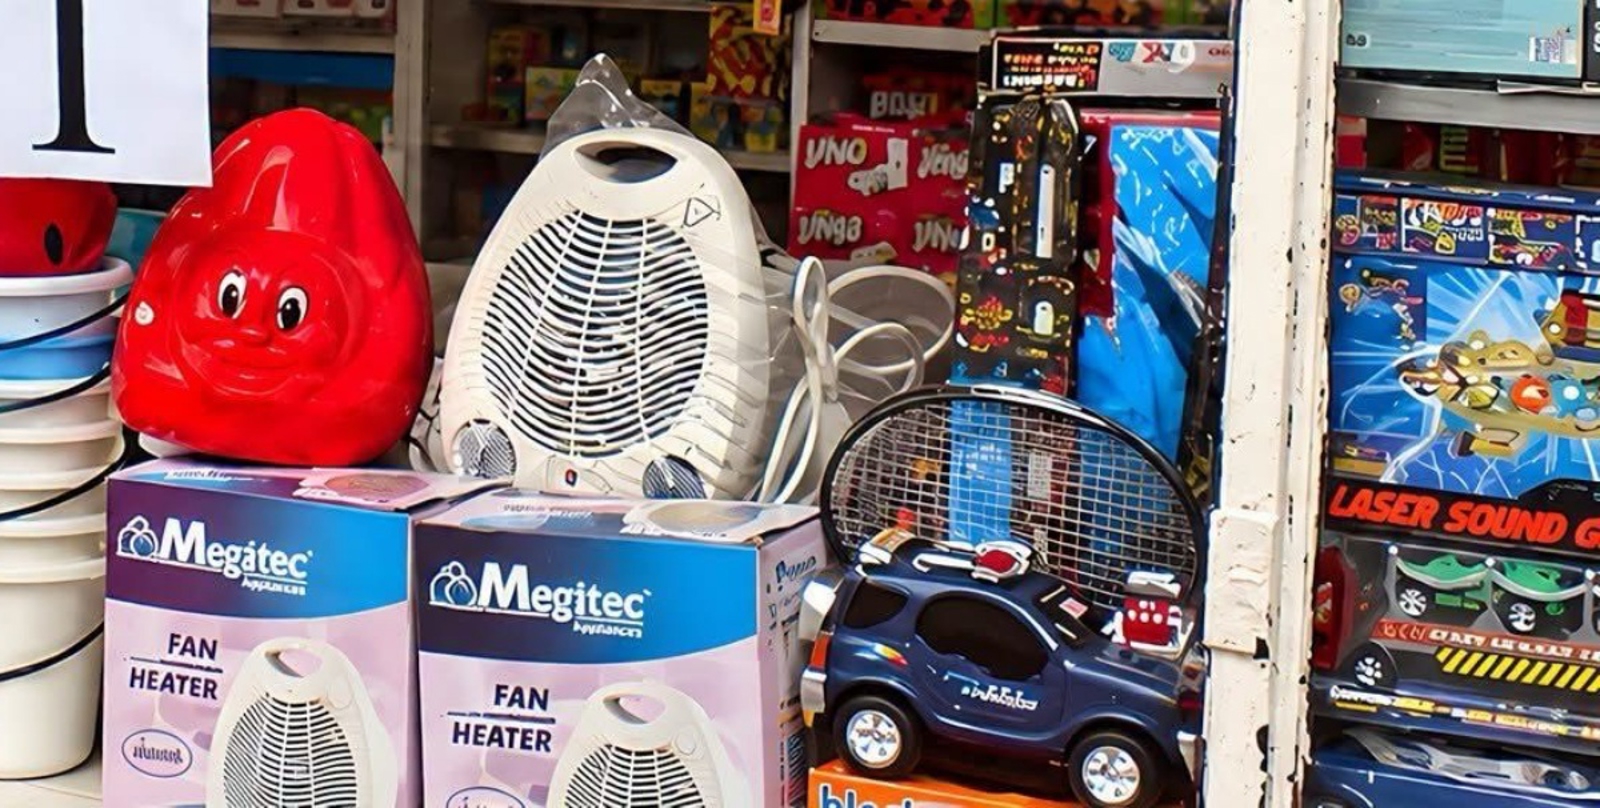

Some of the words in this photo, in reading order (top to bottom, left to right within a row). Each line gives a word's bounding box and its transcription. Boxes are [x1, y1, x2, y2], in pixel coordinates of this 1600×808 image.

[1328, 484, 1439, 529] LASER
[1444, 500, 1568, 544] SOUND
[168, 633, 218, 661] FAN
[129, 667, 218, 700] HEATER
[494, 684, 549, 711] FAN
[452, 721, 552, 752] HEATER
